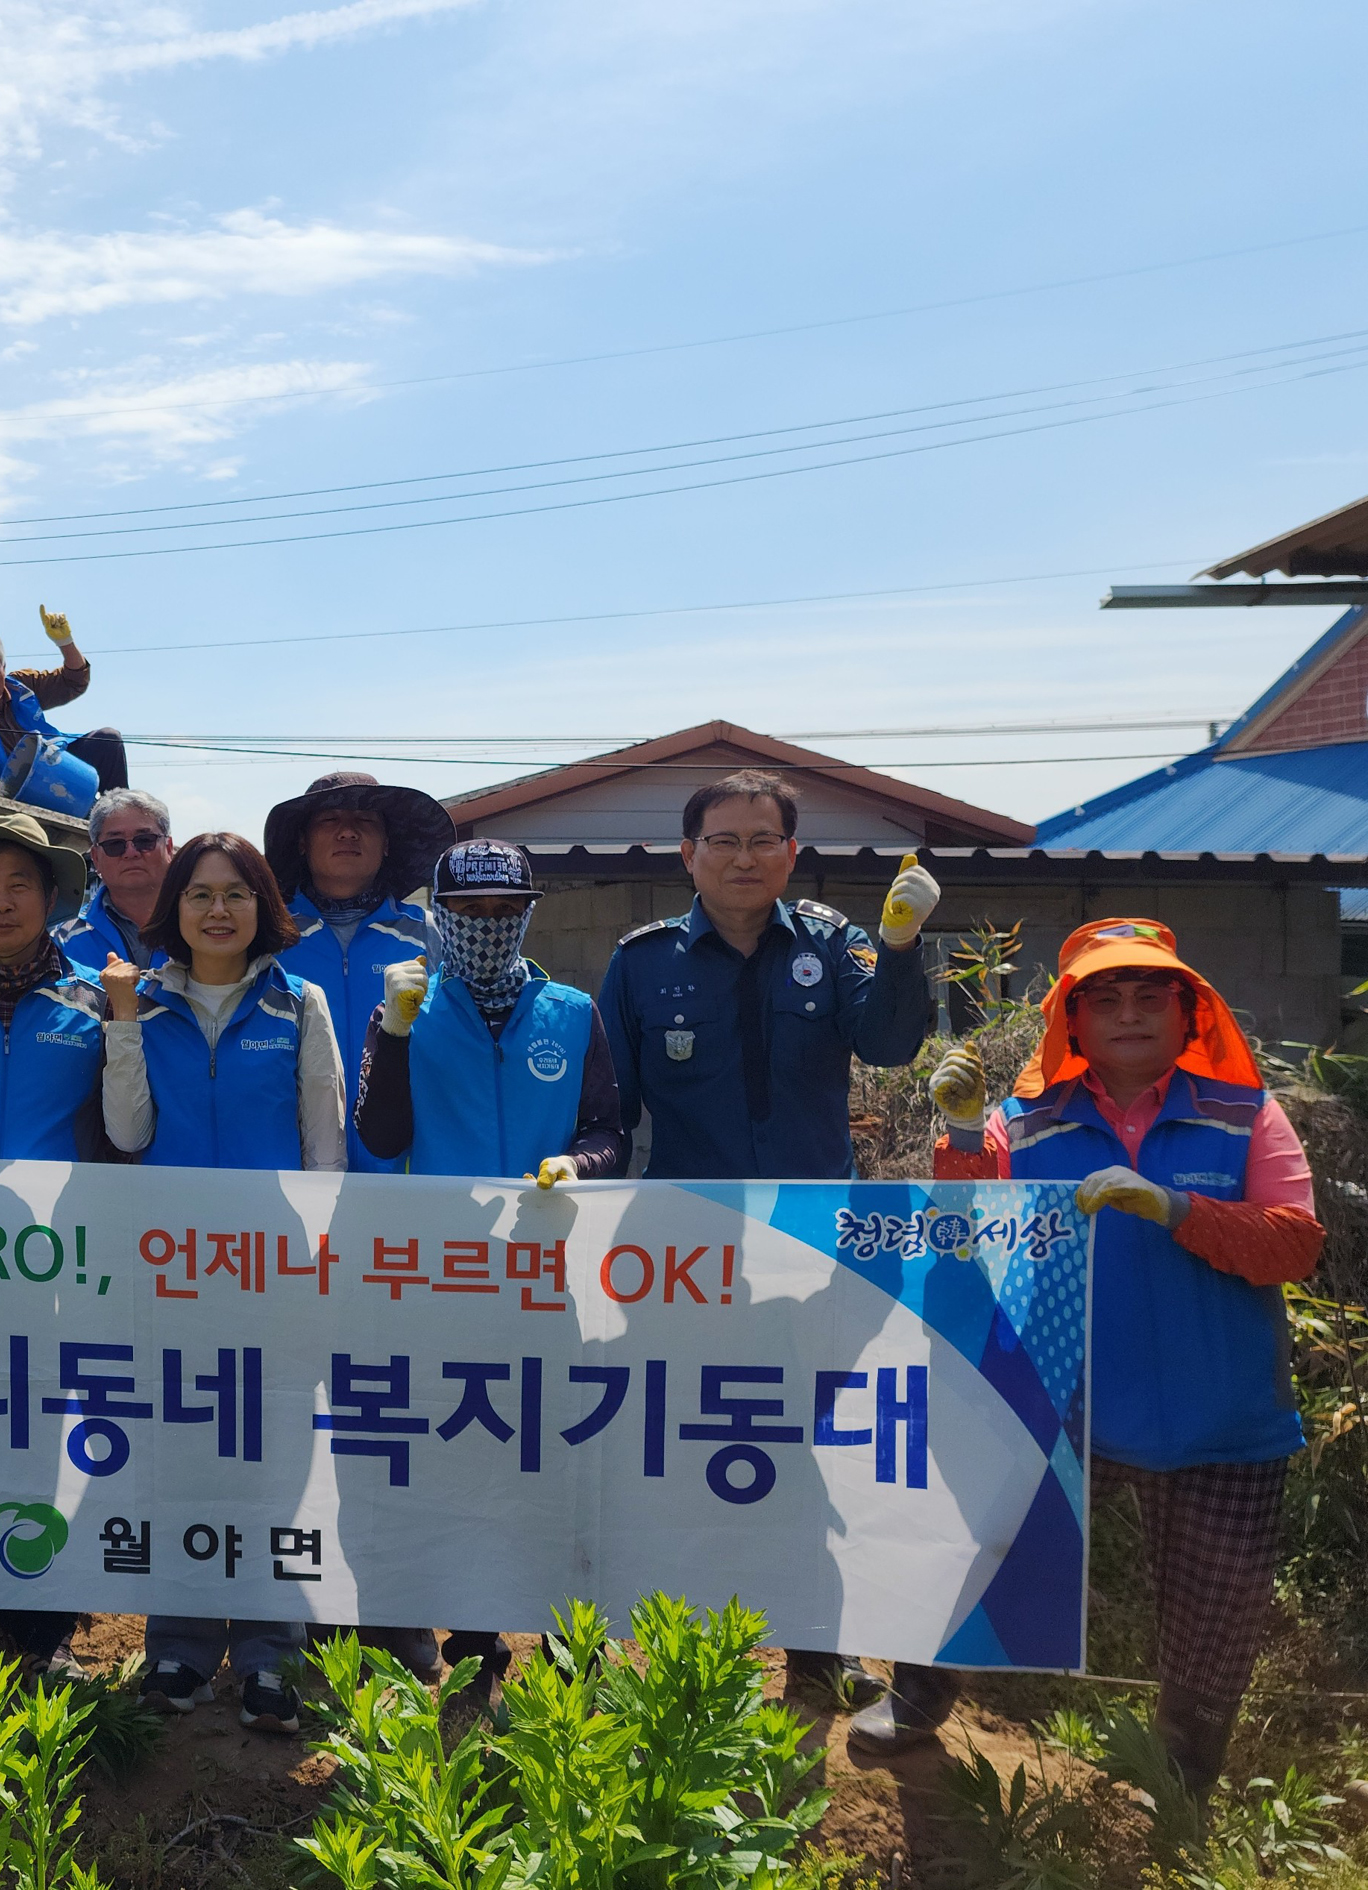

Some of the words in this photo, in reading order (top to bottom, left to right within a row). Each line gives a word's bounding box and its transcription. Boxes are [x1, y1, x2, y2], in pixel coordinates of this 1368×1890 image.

[139, 1228, 340, 1299] 언제나
[362, 1237, 566, 1312] 부르면
[599, 1244, 735, 1305] OK!
[312, 1353, 928, 1504] 복지기동대
